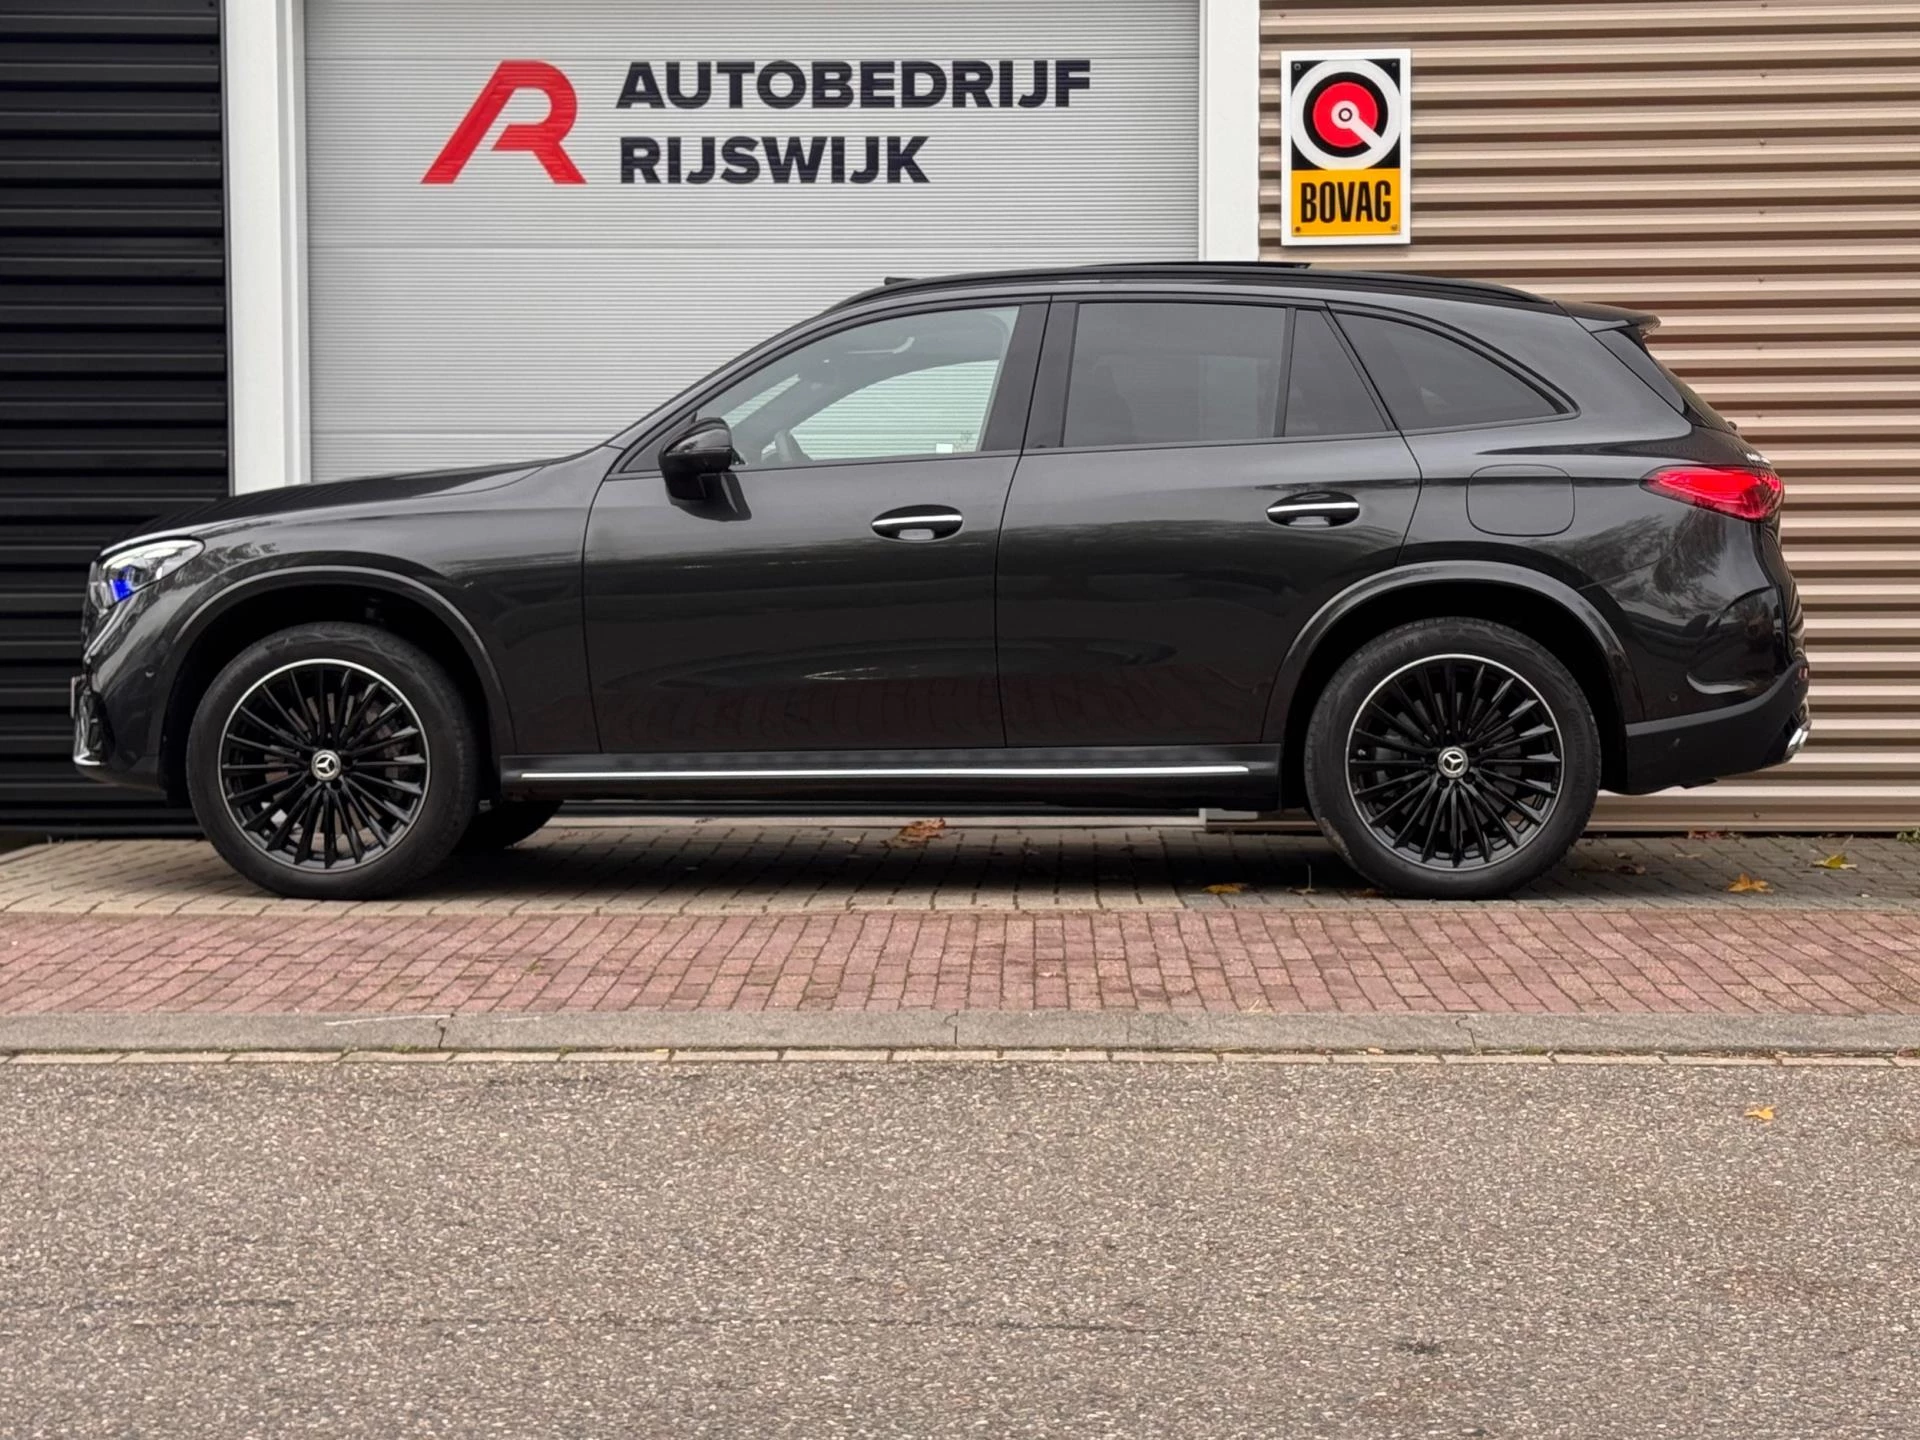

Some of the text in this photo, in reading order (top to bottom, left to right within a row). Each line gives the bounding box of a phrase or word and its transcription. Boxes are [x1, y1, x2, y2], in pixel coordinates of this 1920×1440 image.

[616, 59, 1091, 109] AUTOBEDRIJF
[620, 136, 931, 184] RIJSWIJK
[1300, 180, 1391, 224] BOVAG
